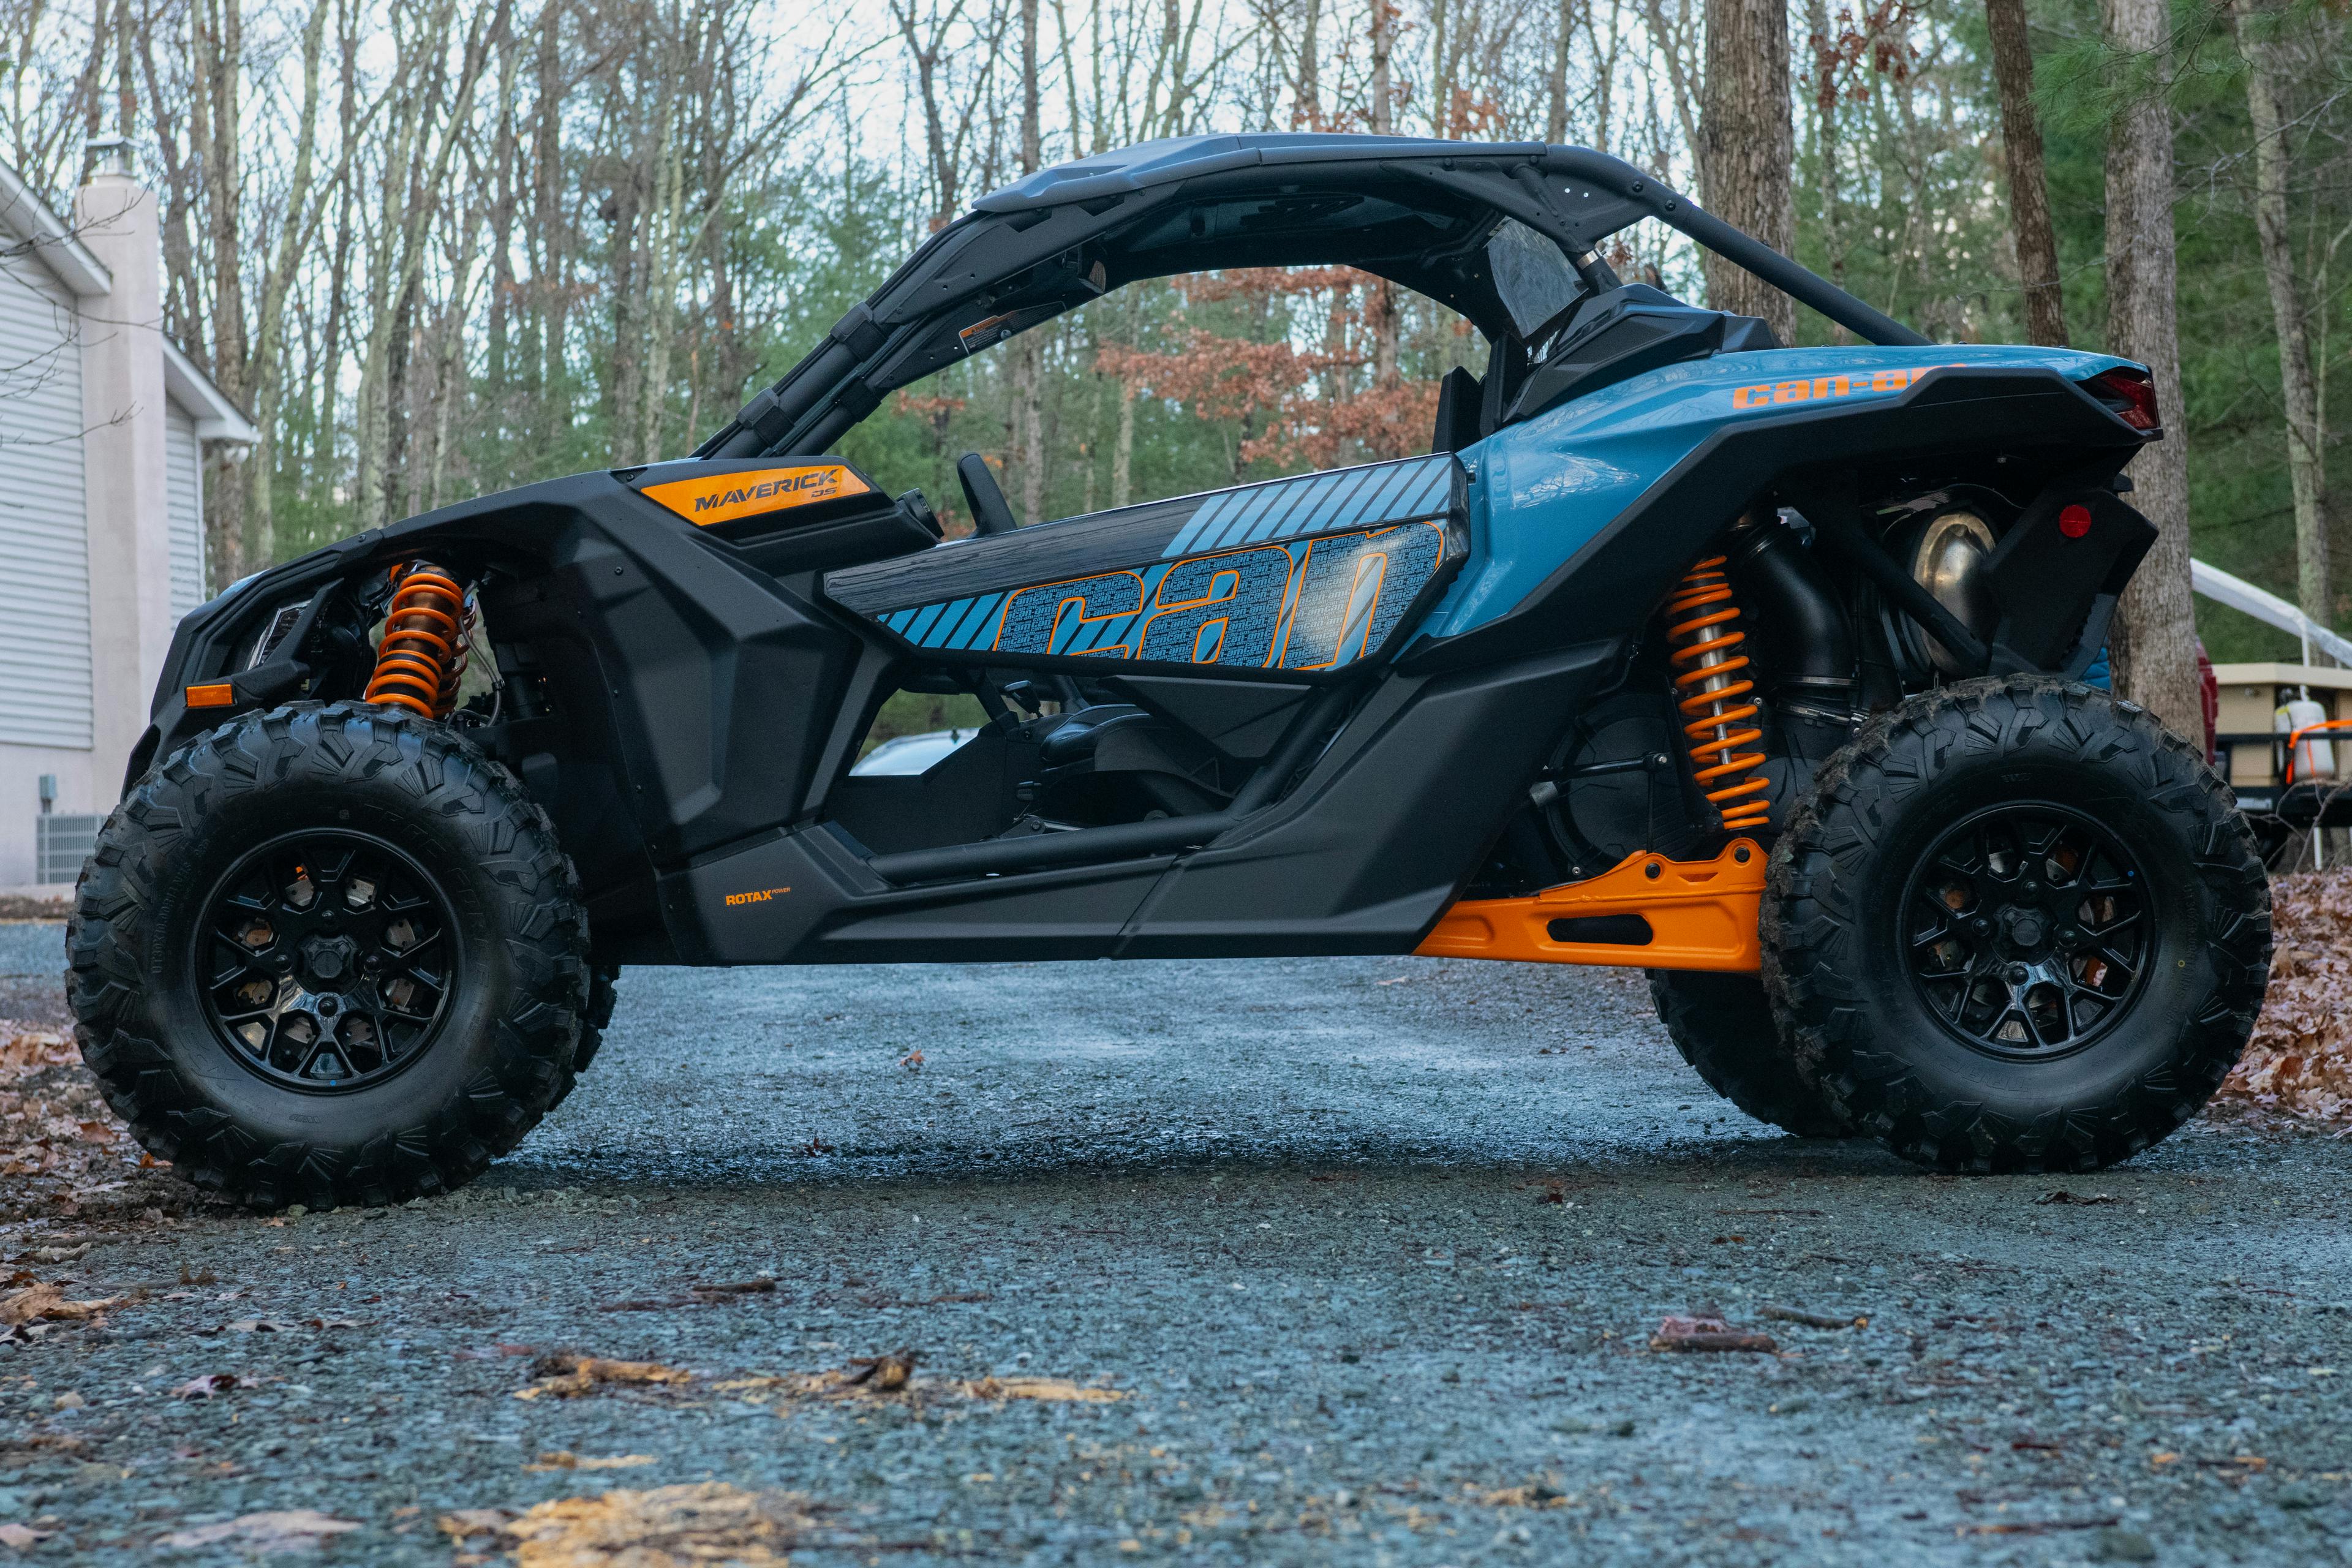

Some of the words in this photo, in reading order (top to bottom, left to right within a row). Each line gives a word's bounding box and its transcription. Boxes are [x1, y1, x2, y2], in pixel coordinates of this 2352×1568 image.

[1733, 364, 1967, 409] can-a
[694, 468, 839, 512] MAVERICK
[811, 487, 837, 498] DS
[725, 889, 772, 906] ROTAX
